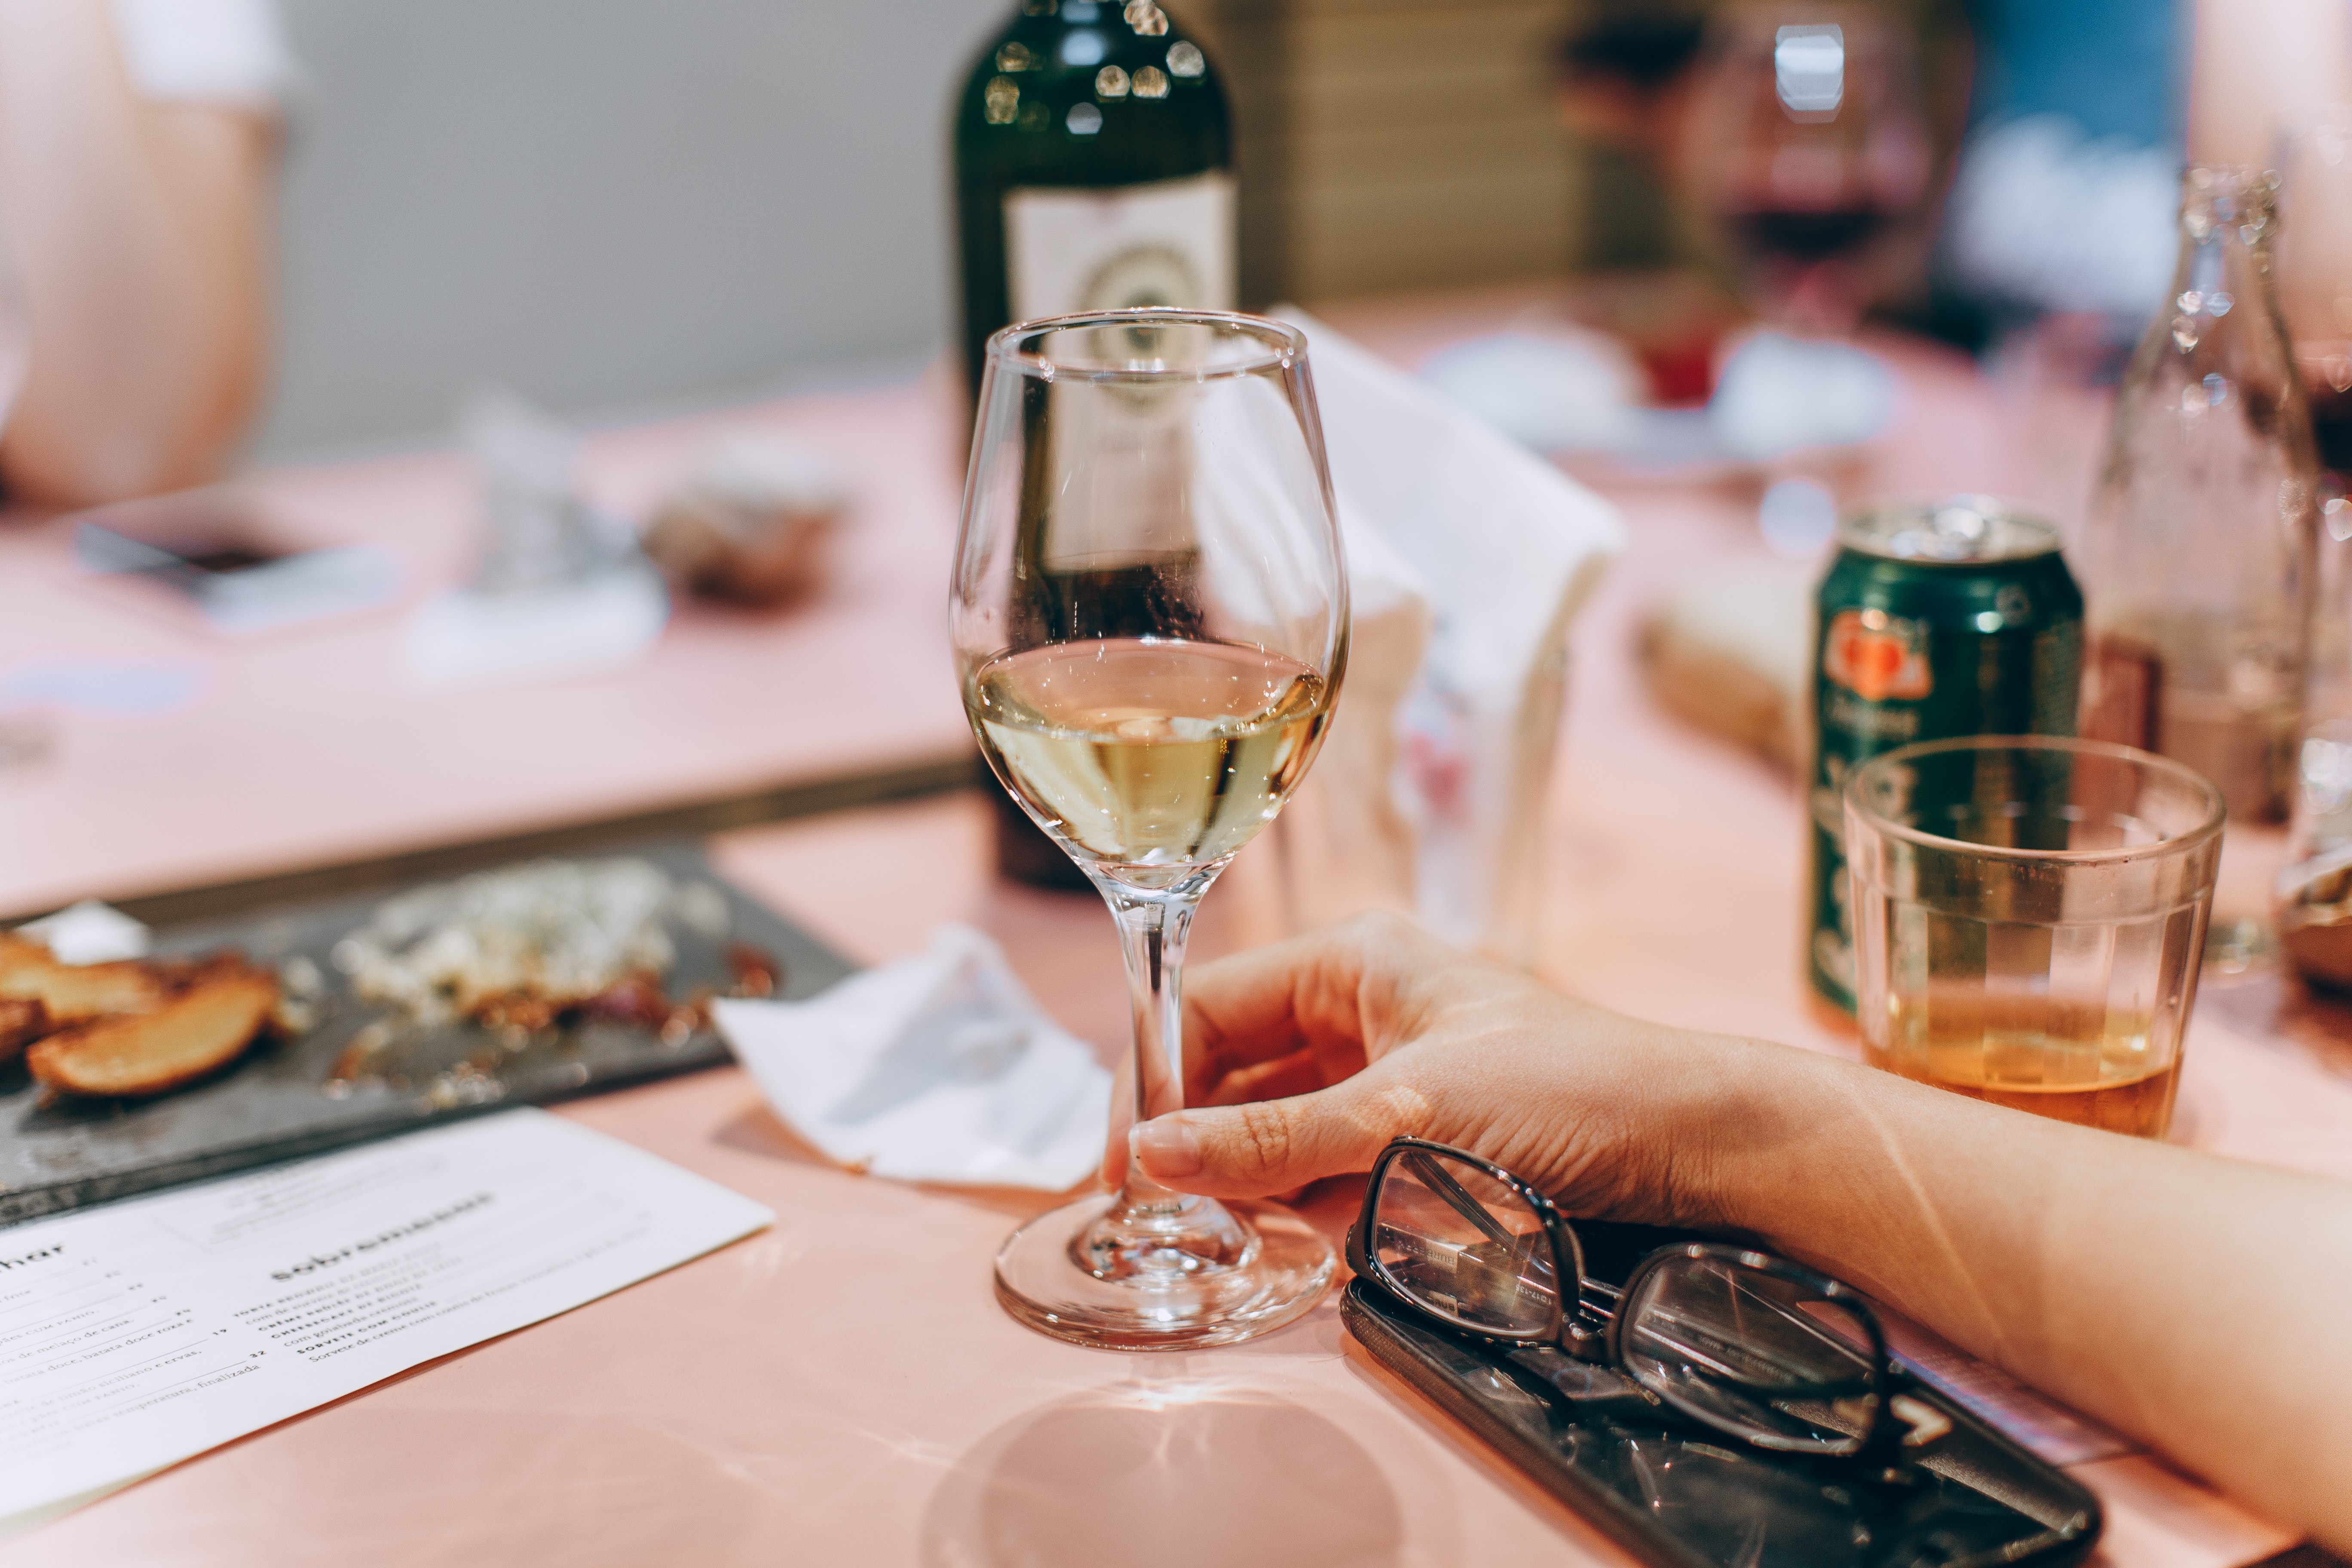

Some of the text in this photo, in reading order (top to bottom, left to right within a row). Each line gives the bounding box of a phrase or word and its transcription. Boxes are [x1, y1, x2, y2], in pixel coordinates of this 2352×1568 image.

[270, 1191, 494, 1282] sobremesas
[0, 1239, 65, 1272] har
[25, 1323, 54, 1335] CUM
[245, 1312, 273, 1325] com
[271, 1308, 353, 1338] CHEESECAKE
[283, 1334, 311, 1347] com
[313, 1316, 367, 1339] goiabada
[0, 1357, 16, 1366] os
[18, 1350, 34, 1359] de
[37, 1336, 82, 1355] melaço
[84, 1326, 99, 1338] de
[47, 1358, 83, 1372] doce,
[83, 1342, 123, 1360] batata
[125, 1332, 155, 1346] doce
[156, 1322, 184, 1334] roxa
[297, 1331, 355, 1354] SORVETE
[358, 1320, 388, 1333] COM
[308, 1342, 356, 1363] Sorvete
[355, 1337, 371, 1346] de
[372, 1324, 410, 1340] creme
[249, 1351, 266, 1359] 32
[58, 1384, 98, 1403] limão
[98, 1366, 153, 1389] siciliano
[165, 1350, 203, 1365] ervas,
[95, 1383, 141, 1400] PANIO.
[112, 1385, 197, 1419] temperatura,
[197, 1363, 261, 1389] finalizada
